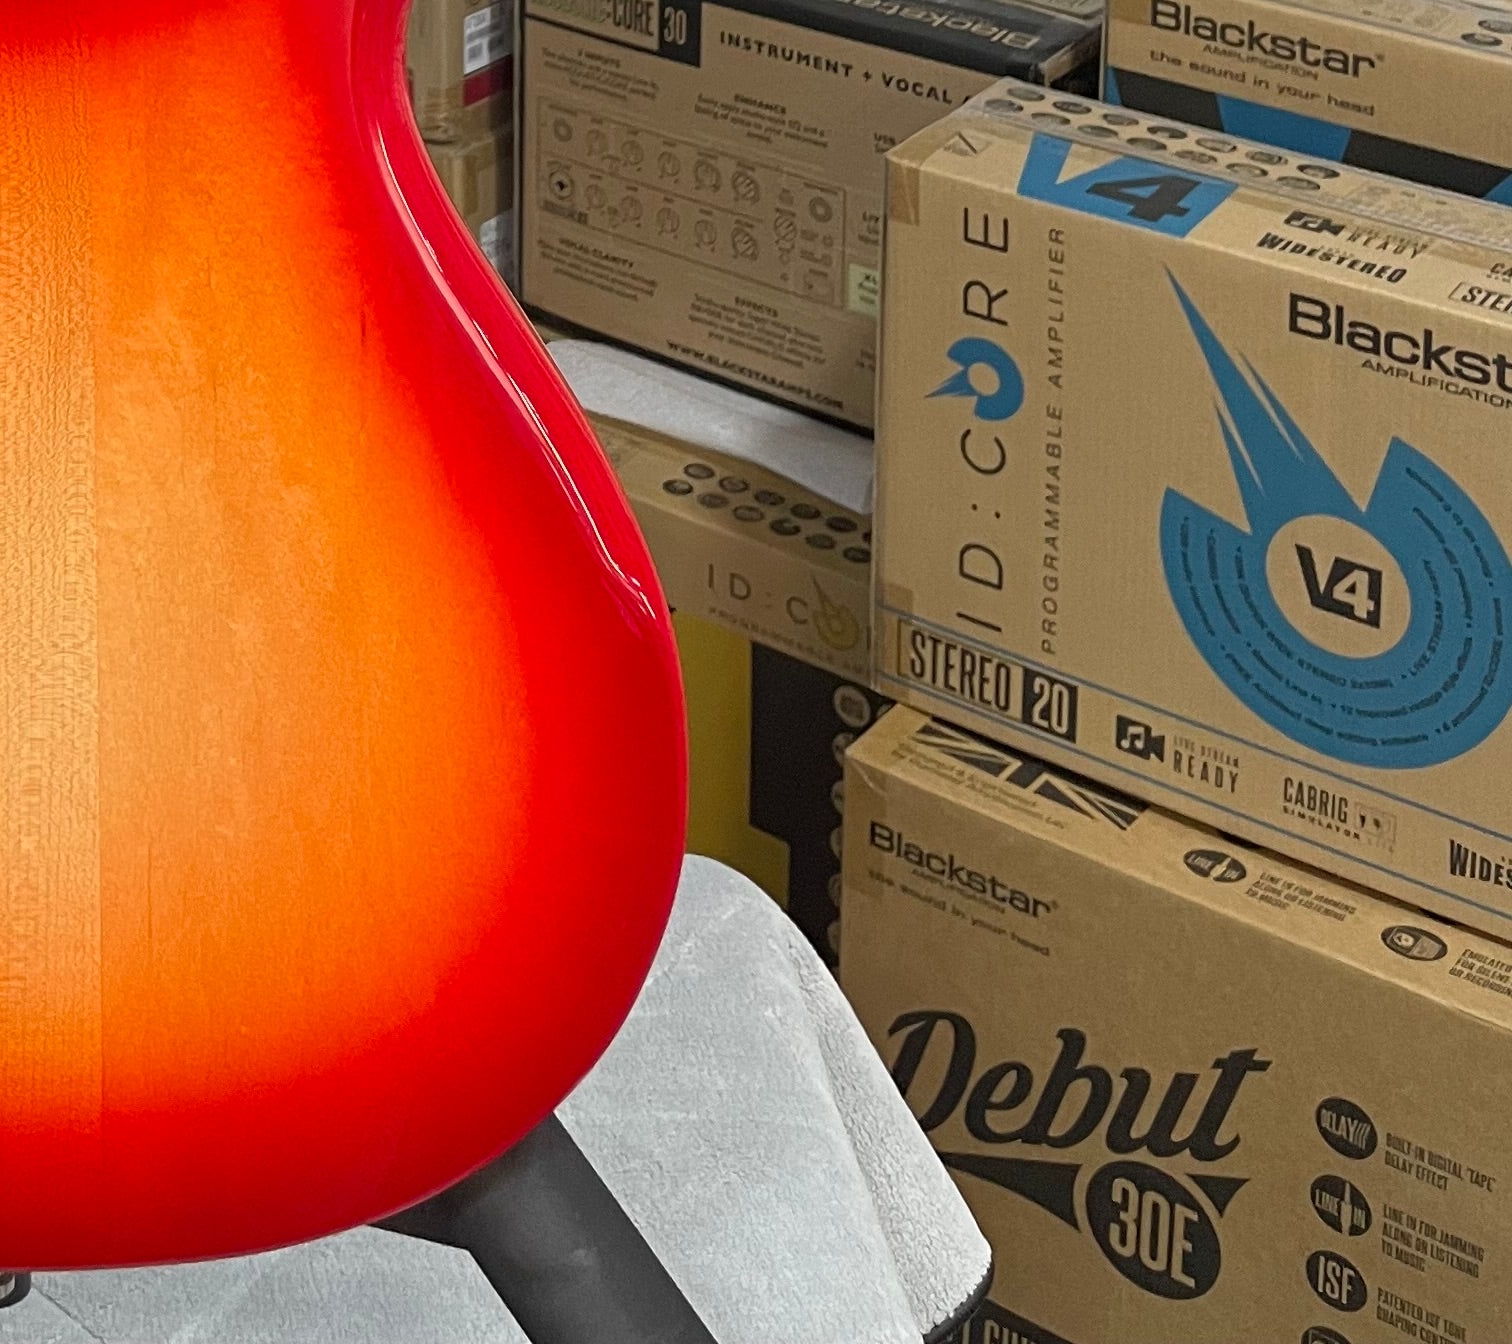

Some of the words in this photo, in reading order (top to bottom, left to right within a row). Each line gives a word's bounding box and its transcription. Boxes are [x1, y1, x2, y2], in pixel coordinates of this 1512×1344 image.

[662, 5, 687, 46] 30
[719, 30, 855, 80] INSTRUMENT
[881, 71, 954, 105] VOCAL
[1149, 50, 1182, 67] the
[1188, 60, 1246, 84] sound
[1252, 74, 1270, 89] in
[1276, 81, 1321, 103] your
[1326, 93, 1376, 118] head
[1047, 227, 1065, 388] AMPLIFIER
[1041, 403, 1064, 655] PROGRAMMABLE
[1294, 542, 1383, 631] V4
[908, 628, 1013, 712] STEREO
[1030, 673, 1071, 735] 20
[1172, 747, 1240, 794] READY
[1282, 776, 1350, 824] CABRIG
[869, 819, 1052, 919] Blackstar
[887, 1009, 1274, 1164] Debut
[1384, 1149, 1414, 1175] DELAY
[1415, 1163, 1450, 1192] EFFECT
[1108, 1176, 1202, 1290] 30E
[1382, 1202, 1404, 1226] LINE
[1405, 1213, 1418, 1231] IN
[1418, 1219, 1437, 1242] FOR
[1414, 1235, 1429, 1256] OR
[1317, 1254, 1356, 1306] ISF
[1376, 1286, 1424, 1322] PATENTED
